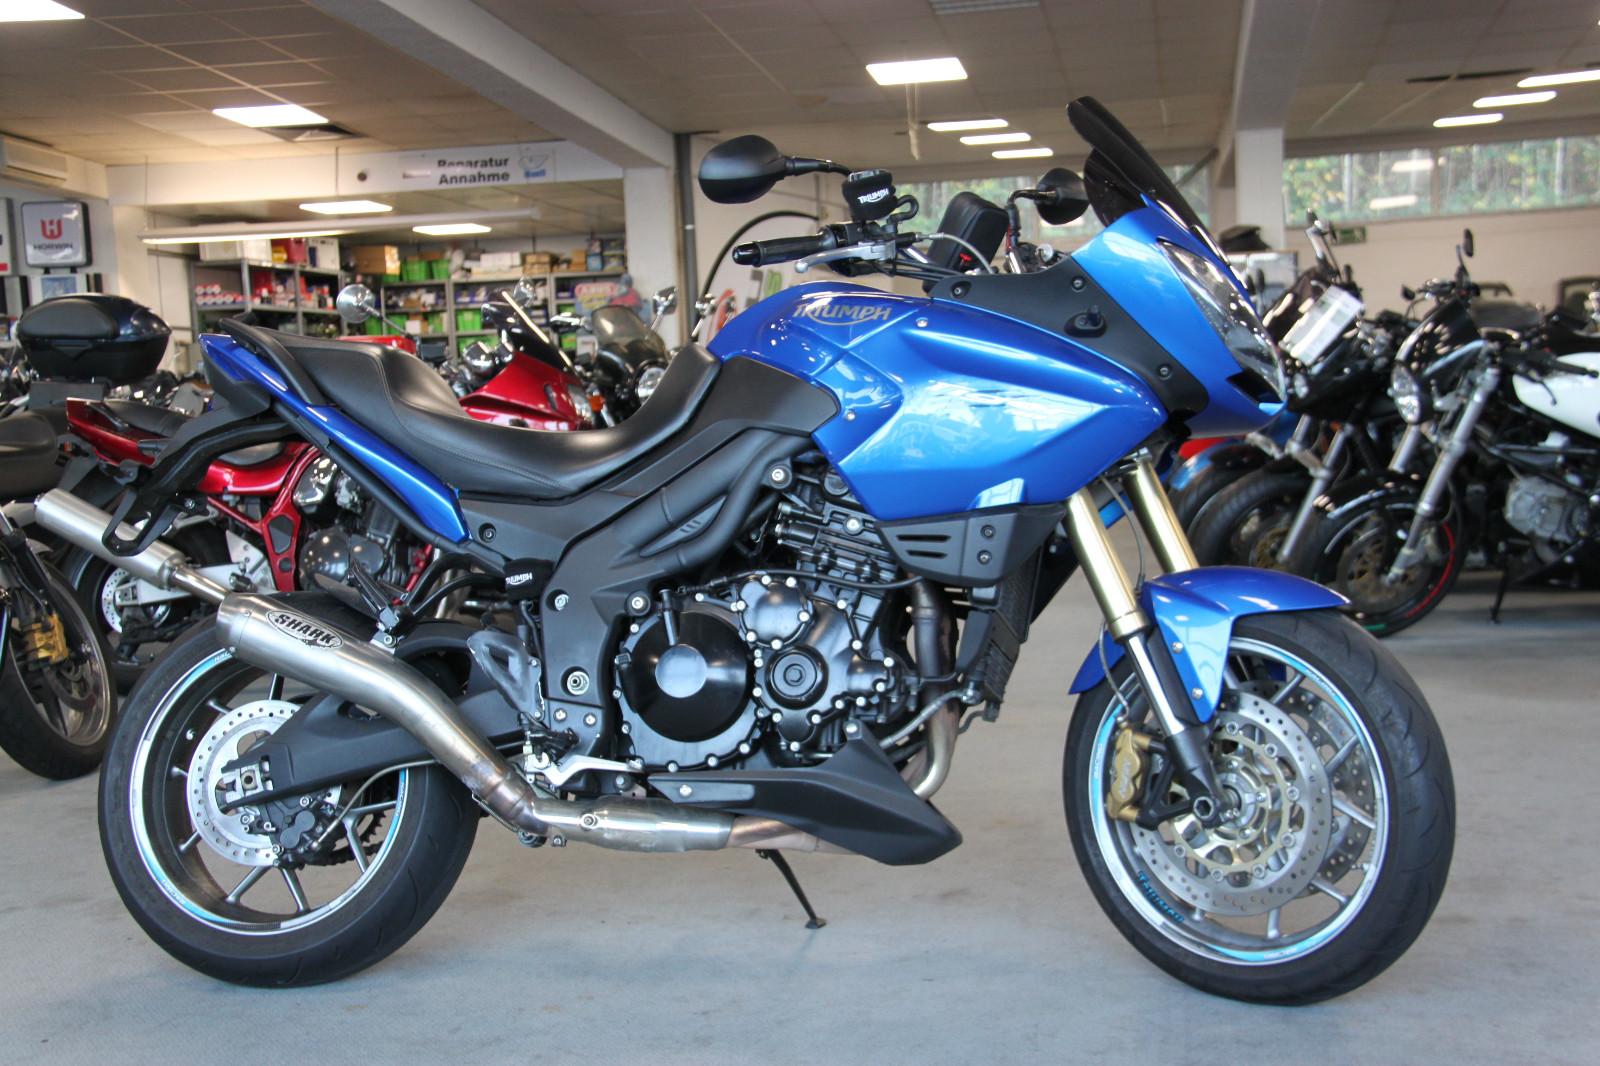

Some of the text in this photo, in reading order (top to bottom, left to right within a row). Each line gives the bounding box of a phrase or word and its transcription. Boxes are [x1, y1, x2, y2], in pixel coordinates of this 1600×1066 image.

[438, 171, 510, 185] Annahme
[857, 188, 889, 204] TRIUMPH
[792, 300, 892, 326] TRIUMPH
[275, 613, 335, 644] SHARK
